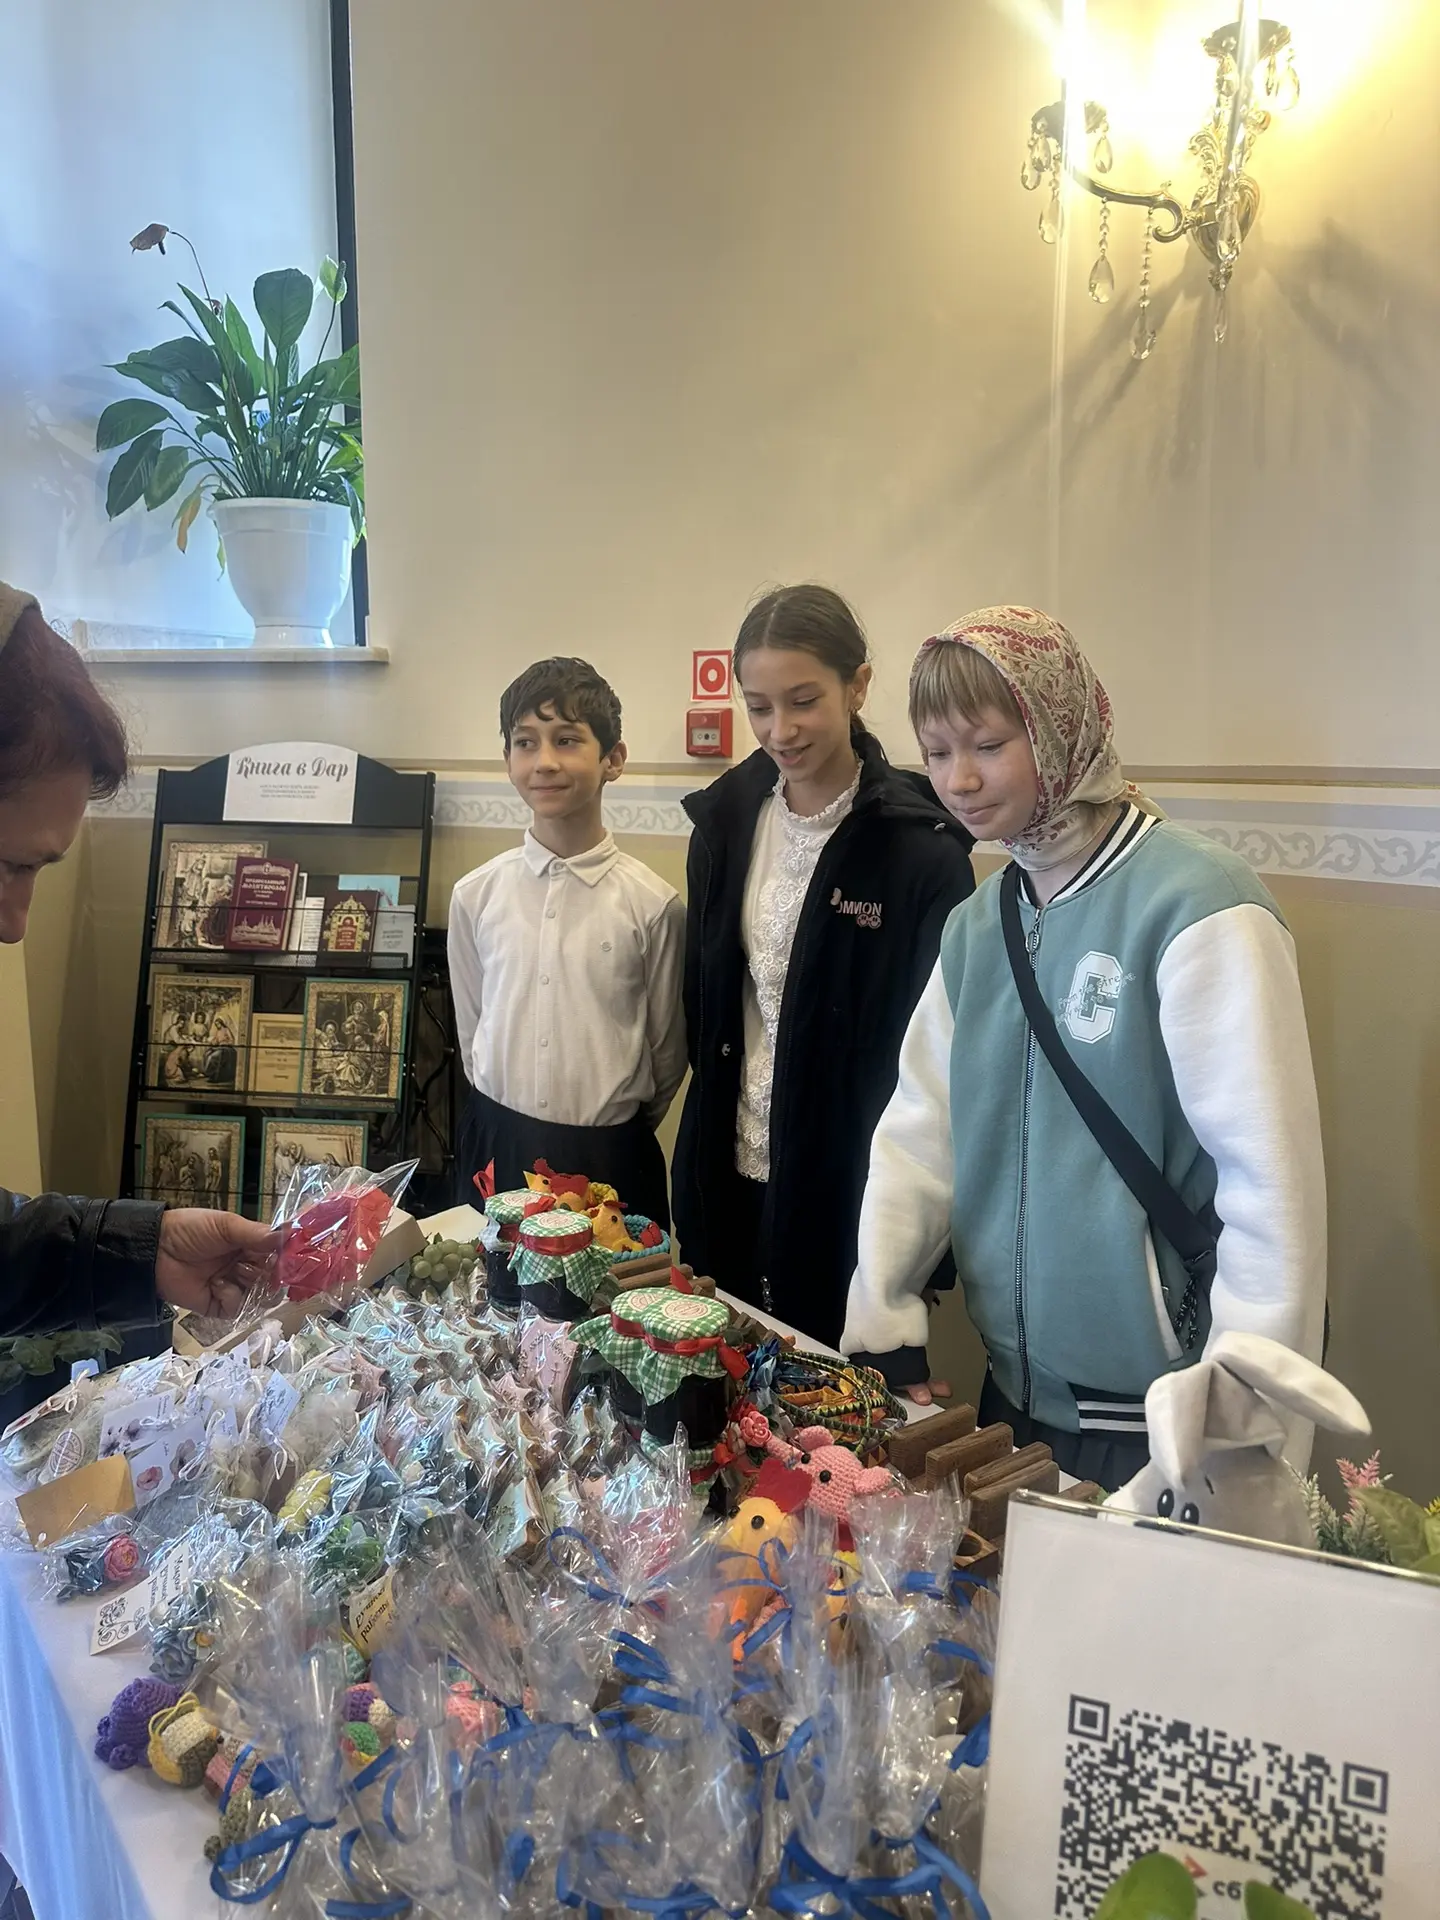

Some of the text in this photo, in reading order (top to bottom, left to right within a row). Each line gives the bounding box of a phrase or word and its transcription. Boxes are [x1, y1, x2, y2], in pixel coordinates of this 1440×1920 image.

[236, 756, 349, 782] Книга в Дар
[1064, 950, 1124, 1045] C
